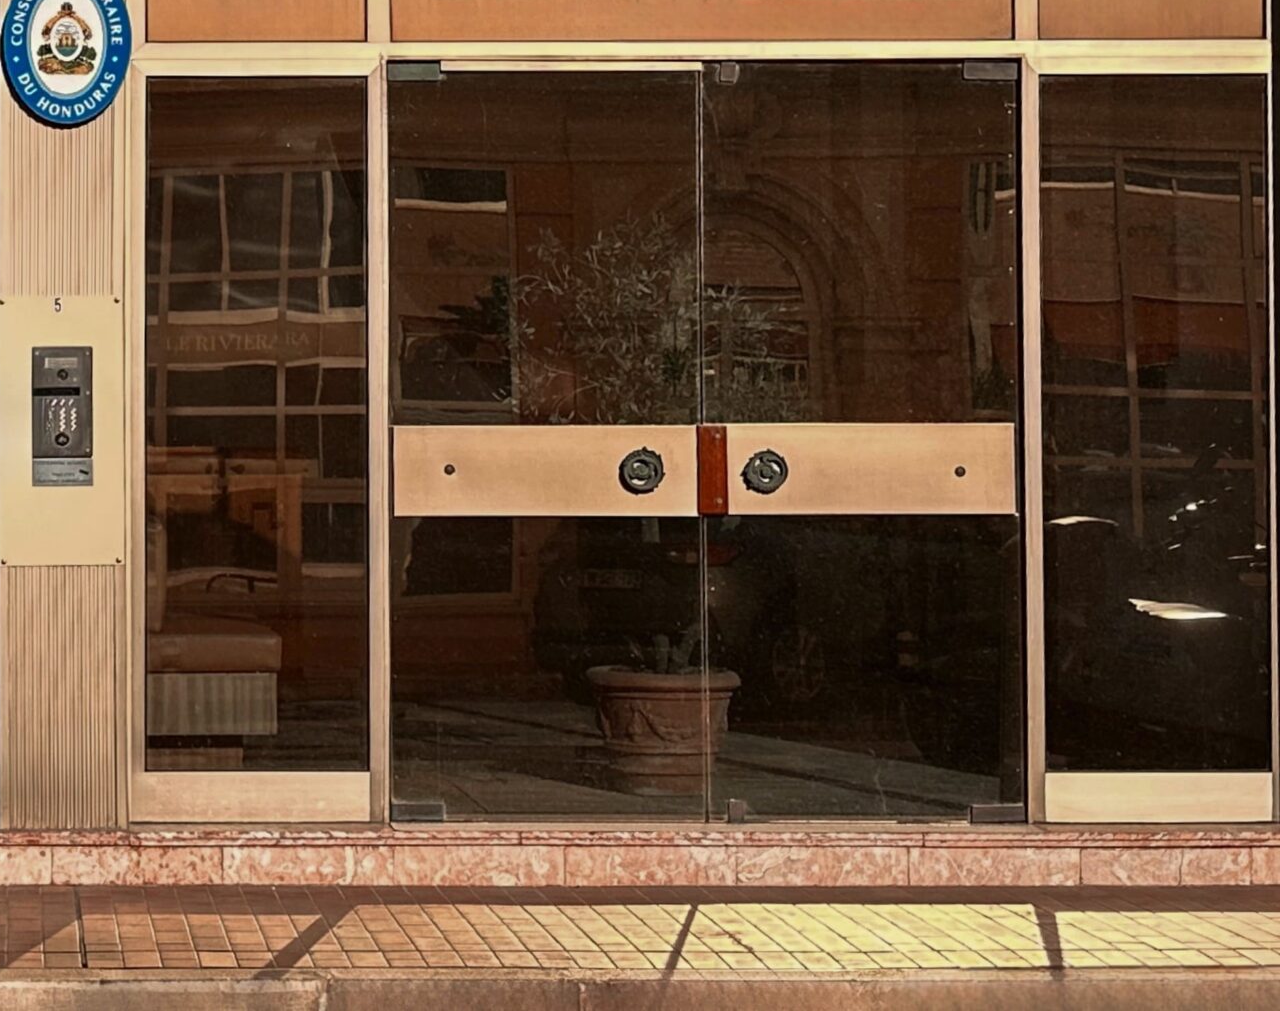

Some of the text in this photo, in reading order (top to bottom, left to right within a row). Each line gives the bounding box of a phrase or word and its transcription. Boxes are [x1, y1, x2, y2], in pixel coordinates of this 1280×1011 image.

[18, 71, 116, 118] DU HONDURAS
[54, 297, 62, 313] 5
